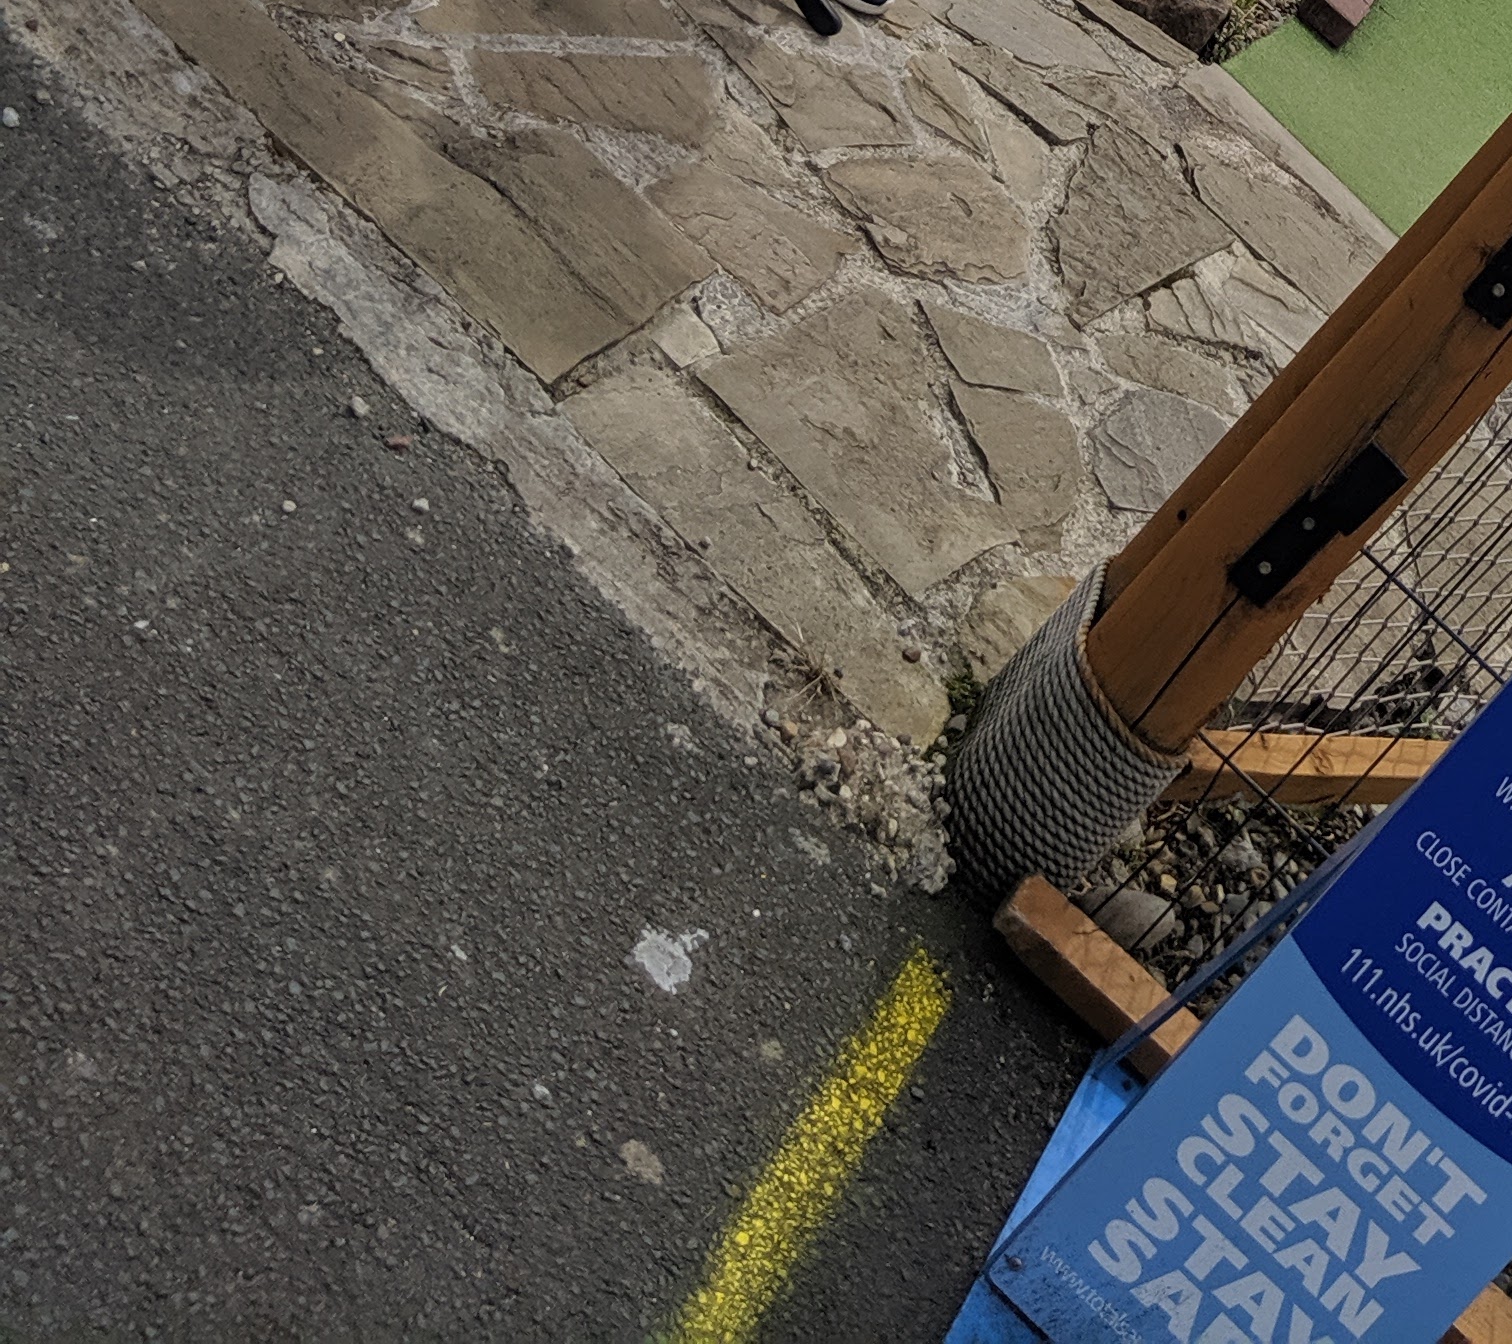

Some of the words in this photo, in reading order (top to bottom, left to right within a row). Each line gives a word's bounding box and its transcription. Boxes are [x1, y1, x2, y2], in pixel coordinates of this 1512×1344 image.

[1415, 830, 1472, 886] CLOSE
[1394, 932, 1456, 997] SOCIAL
[1199, 1093, 1422, 1289] STAY
[1243, 1049, 1456, 1246] FORGET
[1269, 1013, 1488, 1214] DON'T
[1176, 1135, 1385, 1340] CLEAN
